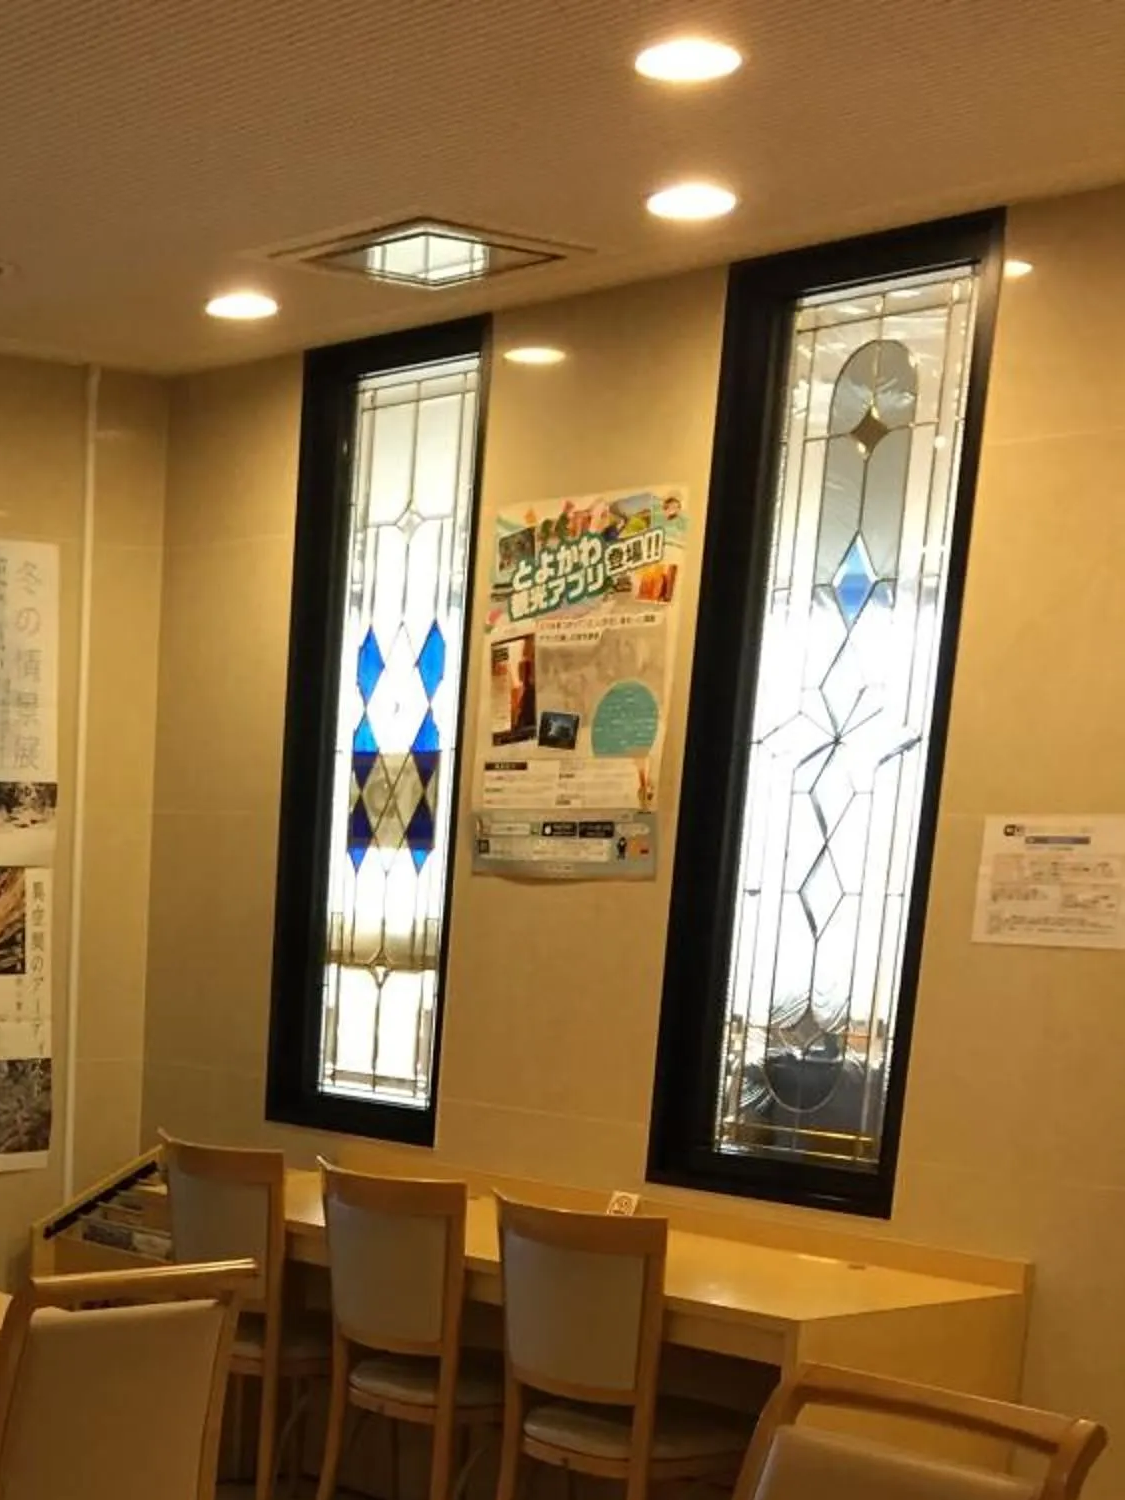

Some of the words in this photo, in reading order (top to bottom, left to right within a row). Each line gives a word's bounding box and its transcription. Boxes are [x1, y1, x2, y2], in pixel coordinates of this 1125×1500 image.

[512, 536, 603, 591] とよかわ
[14, 559, 43, 770] 冬の情景展
